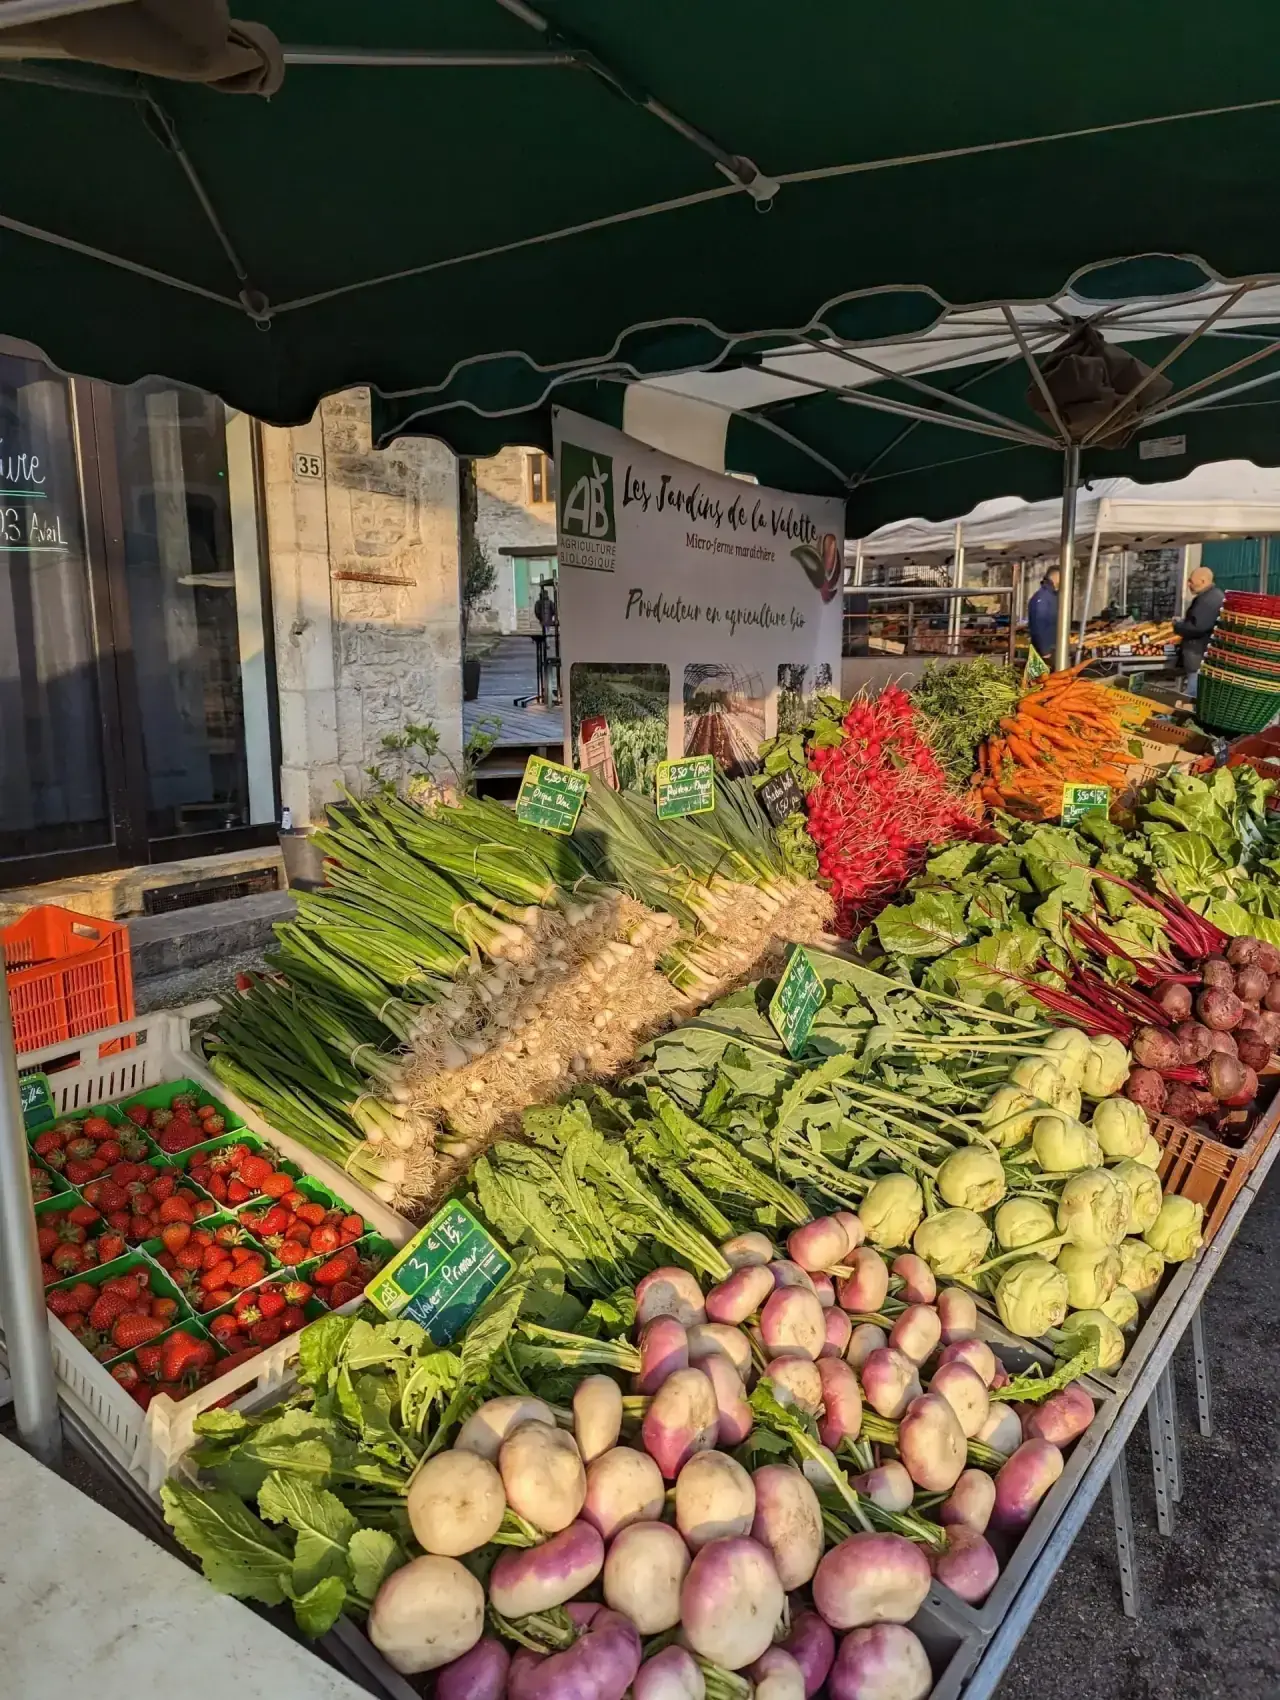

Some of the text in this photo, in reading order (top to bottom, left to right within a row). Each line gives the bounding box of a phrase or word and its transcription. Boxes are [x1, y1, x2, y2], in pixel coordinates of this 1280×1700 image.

[299, 456, 319, 475] 35
[563, 475, 609, 537] AB
[622, 464, 819, 544] Les Jardins de la Valette
[560, 538, 616, 556] AGRICULTURE
[560, 552, 615, 569] BIOLOGIQUE
[685, 532, 775, 562] Micro-ferme maraîchère
[625, 588, 806, 637] Producteur en agriculture bio
[409, 1258, 429, 1279] 3
[427, 1237, 440, 1251] €
[381, 1286, 398, 1308] AB
